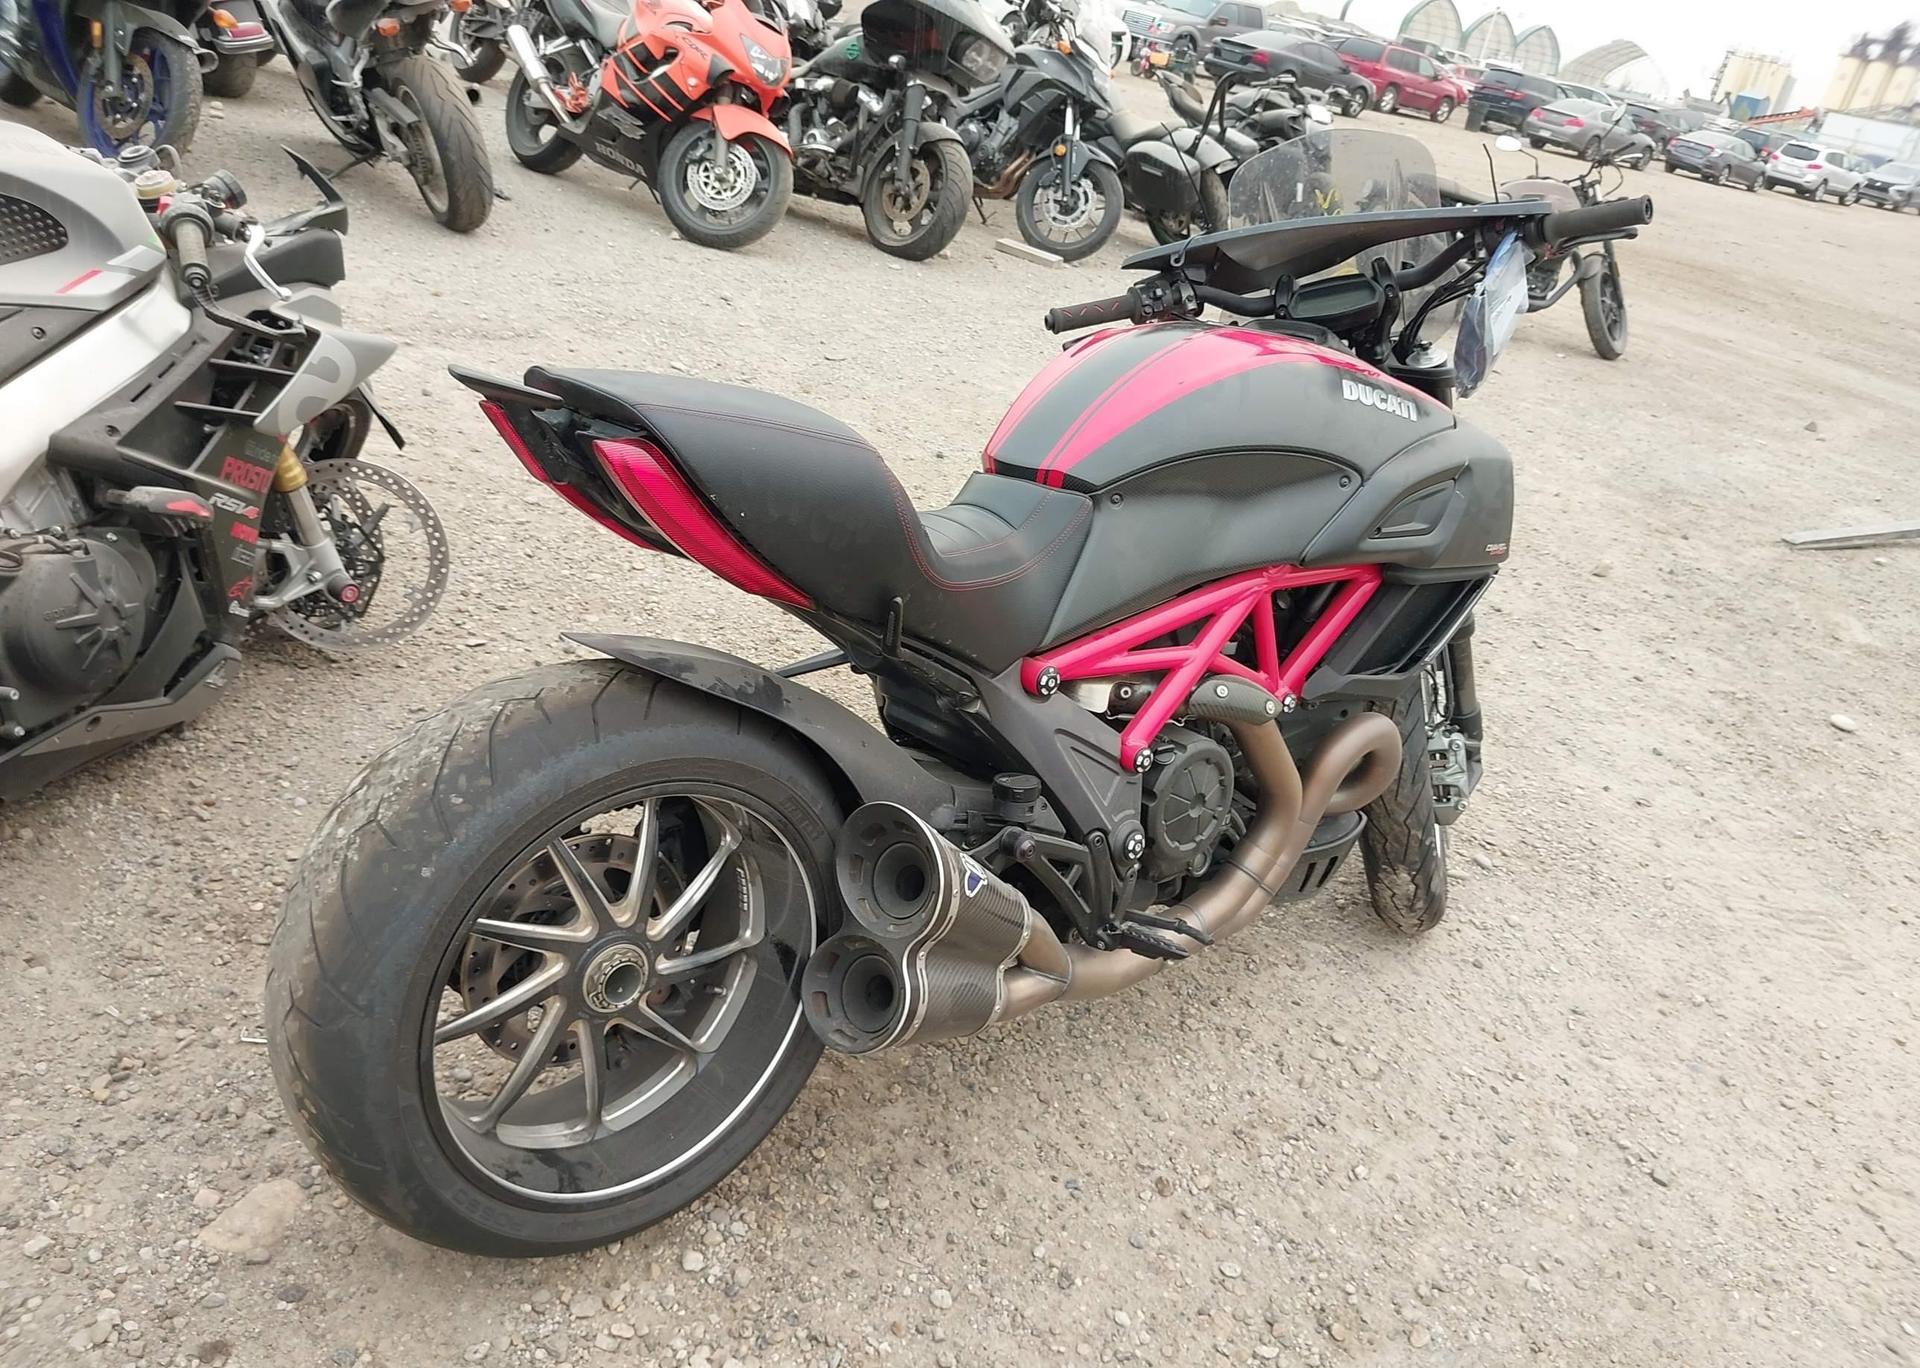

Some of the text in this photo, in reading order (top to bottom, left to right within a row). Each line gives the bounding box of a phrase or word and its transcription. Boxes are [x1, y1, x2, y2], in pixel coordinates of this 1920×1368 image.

[594, 142, 648, 178] HONDA
[1342, 379, 1418, 422] DUCATI
[208, 492, 260, 520] RSV4
